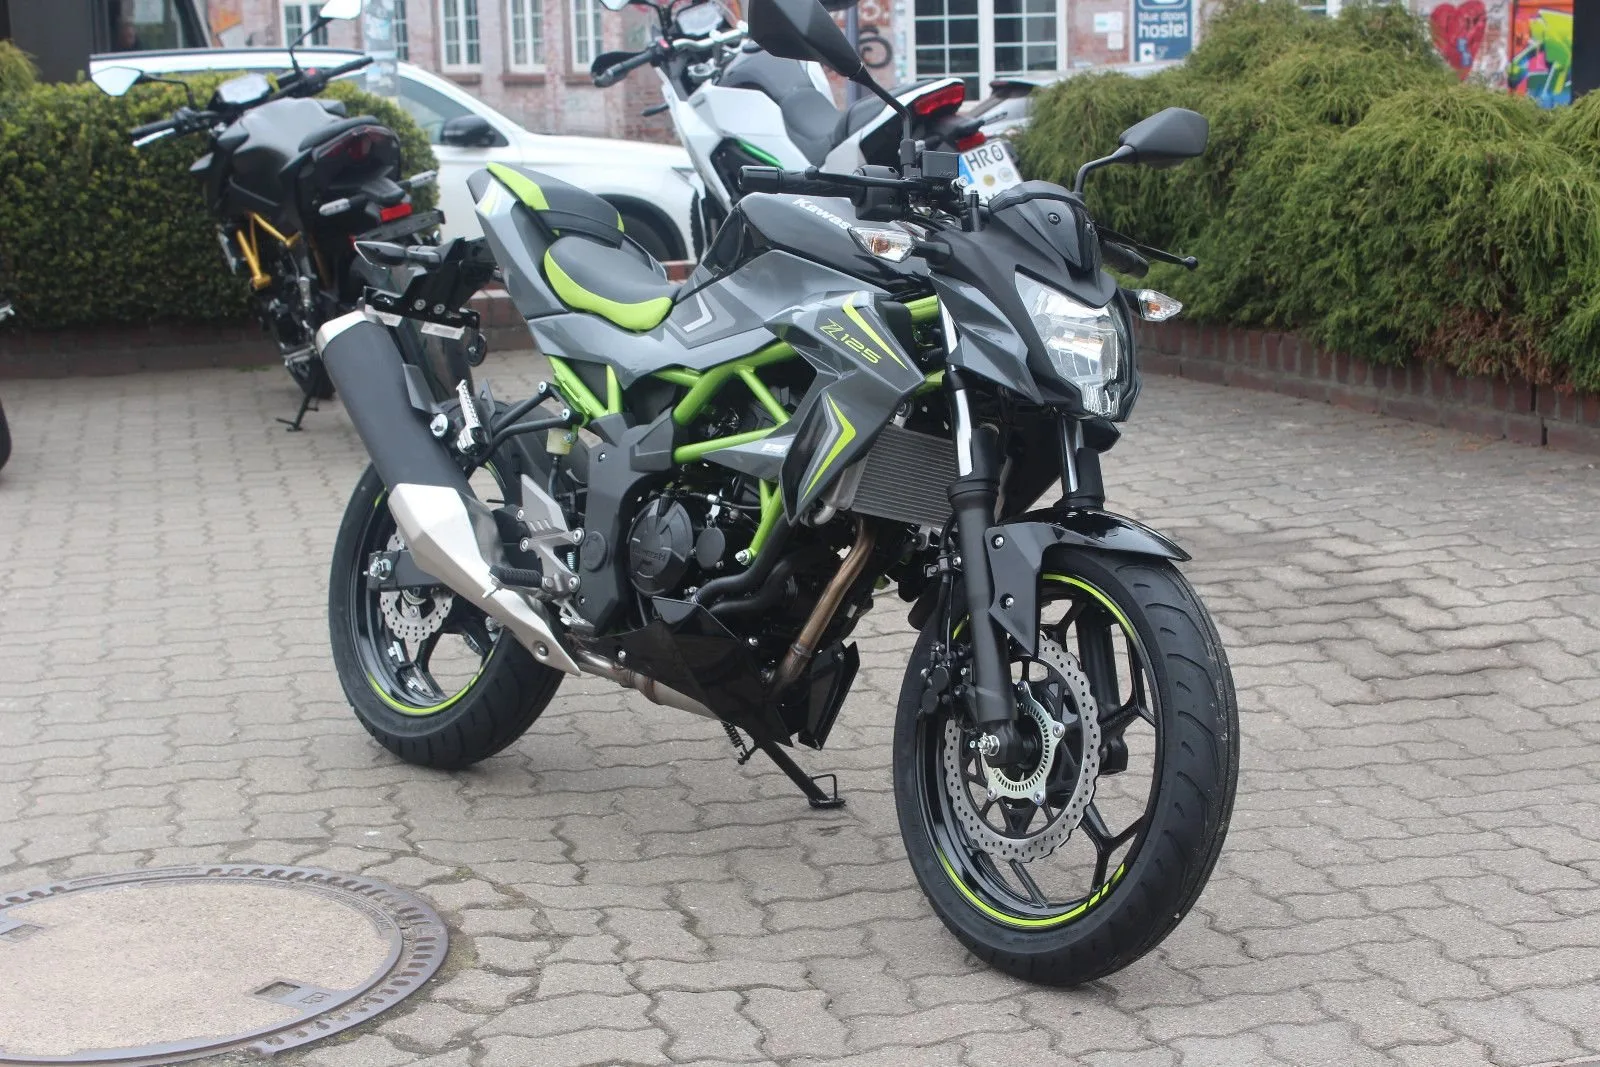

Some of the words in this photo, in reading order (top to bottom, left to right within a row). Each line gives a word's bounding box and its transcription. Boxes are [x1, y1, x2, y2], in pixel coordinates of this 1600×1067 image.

[1138, 20, 1188, 39] hostel
[965, 144, 1004, 172] HRO
[792, 198, 853, 230] Kawas
